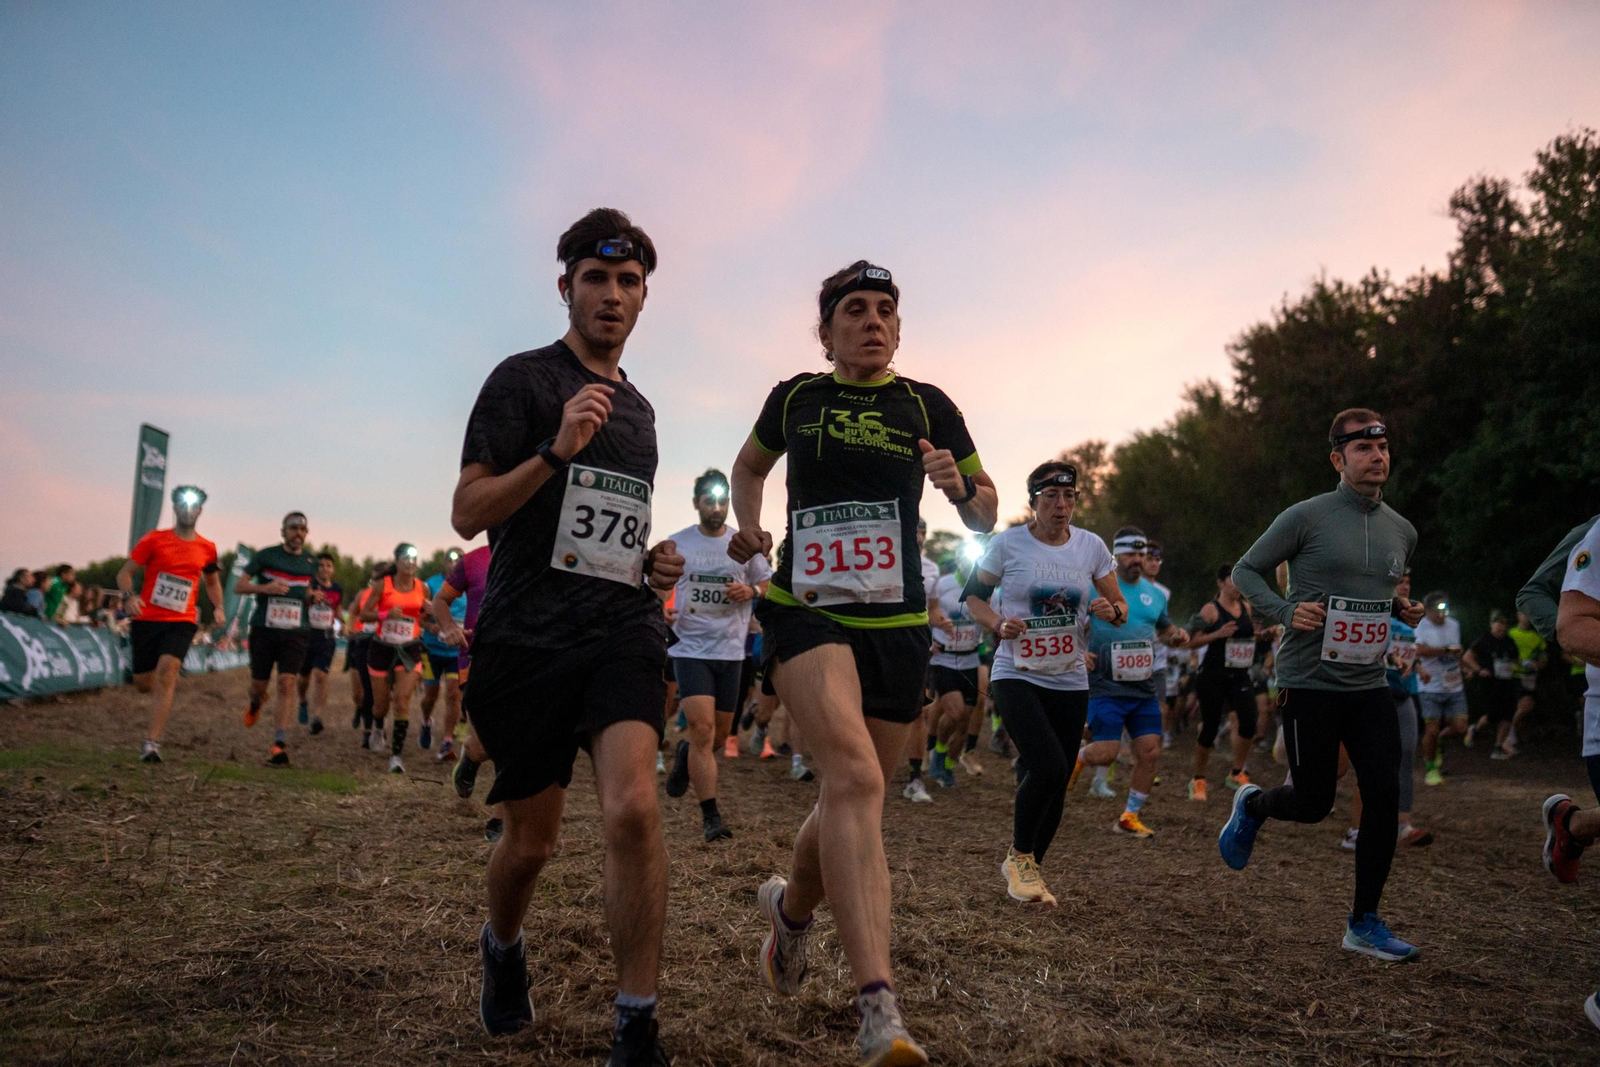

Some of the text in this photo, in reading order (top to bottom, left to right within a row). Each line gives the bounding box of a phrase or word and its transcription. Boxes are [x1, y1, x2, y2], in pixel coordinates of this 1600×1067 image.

[844, 428, 872, 439] RUTA
[844, 437, 913, 456] RECONQUISTA
[602, 476, 645, 499] ITÁLICA
[823, 506, 872, 522] ITÁLICA
[571, 505, 648, 554] 3784
[804, 536, 896, 576] 3153
[156, 583, 188, 602] 3710
[1351, 602, 1381, 611] ITÁLICA
[1030, 618, 1061, 628] ITÁLICA
[1332, 621, 1387, 644] 3559
[1020, 635, 1074, 659] 3538
[1117, 654, 1152, 669] 3089
